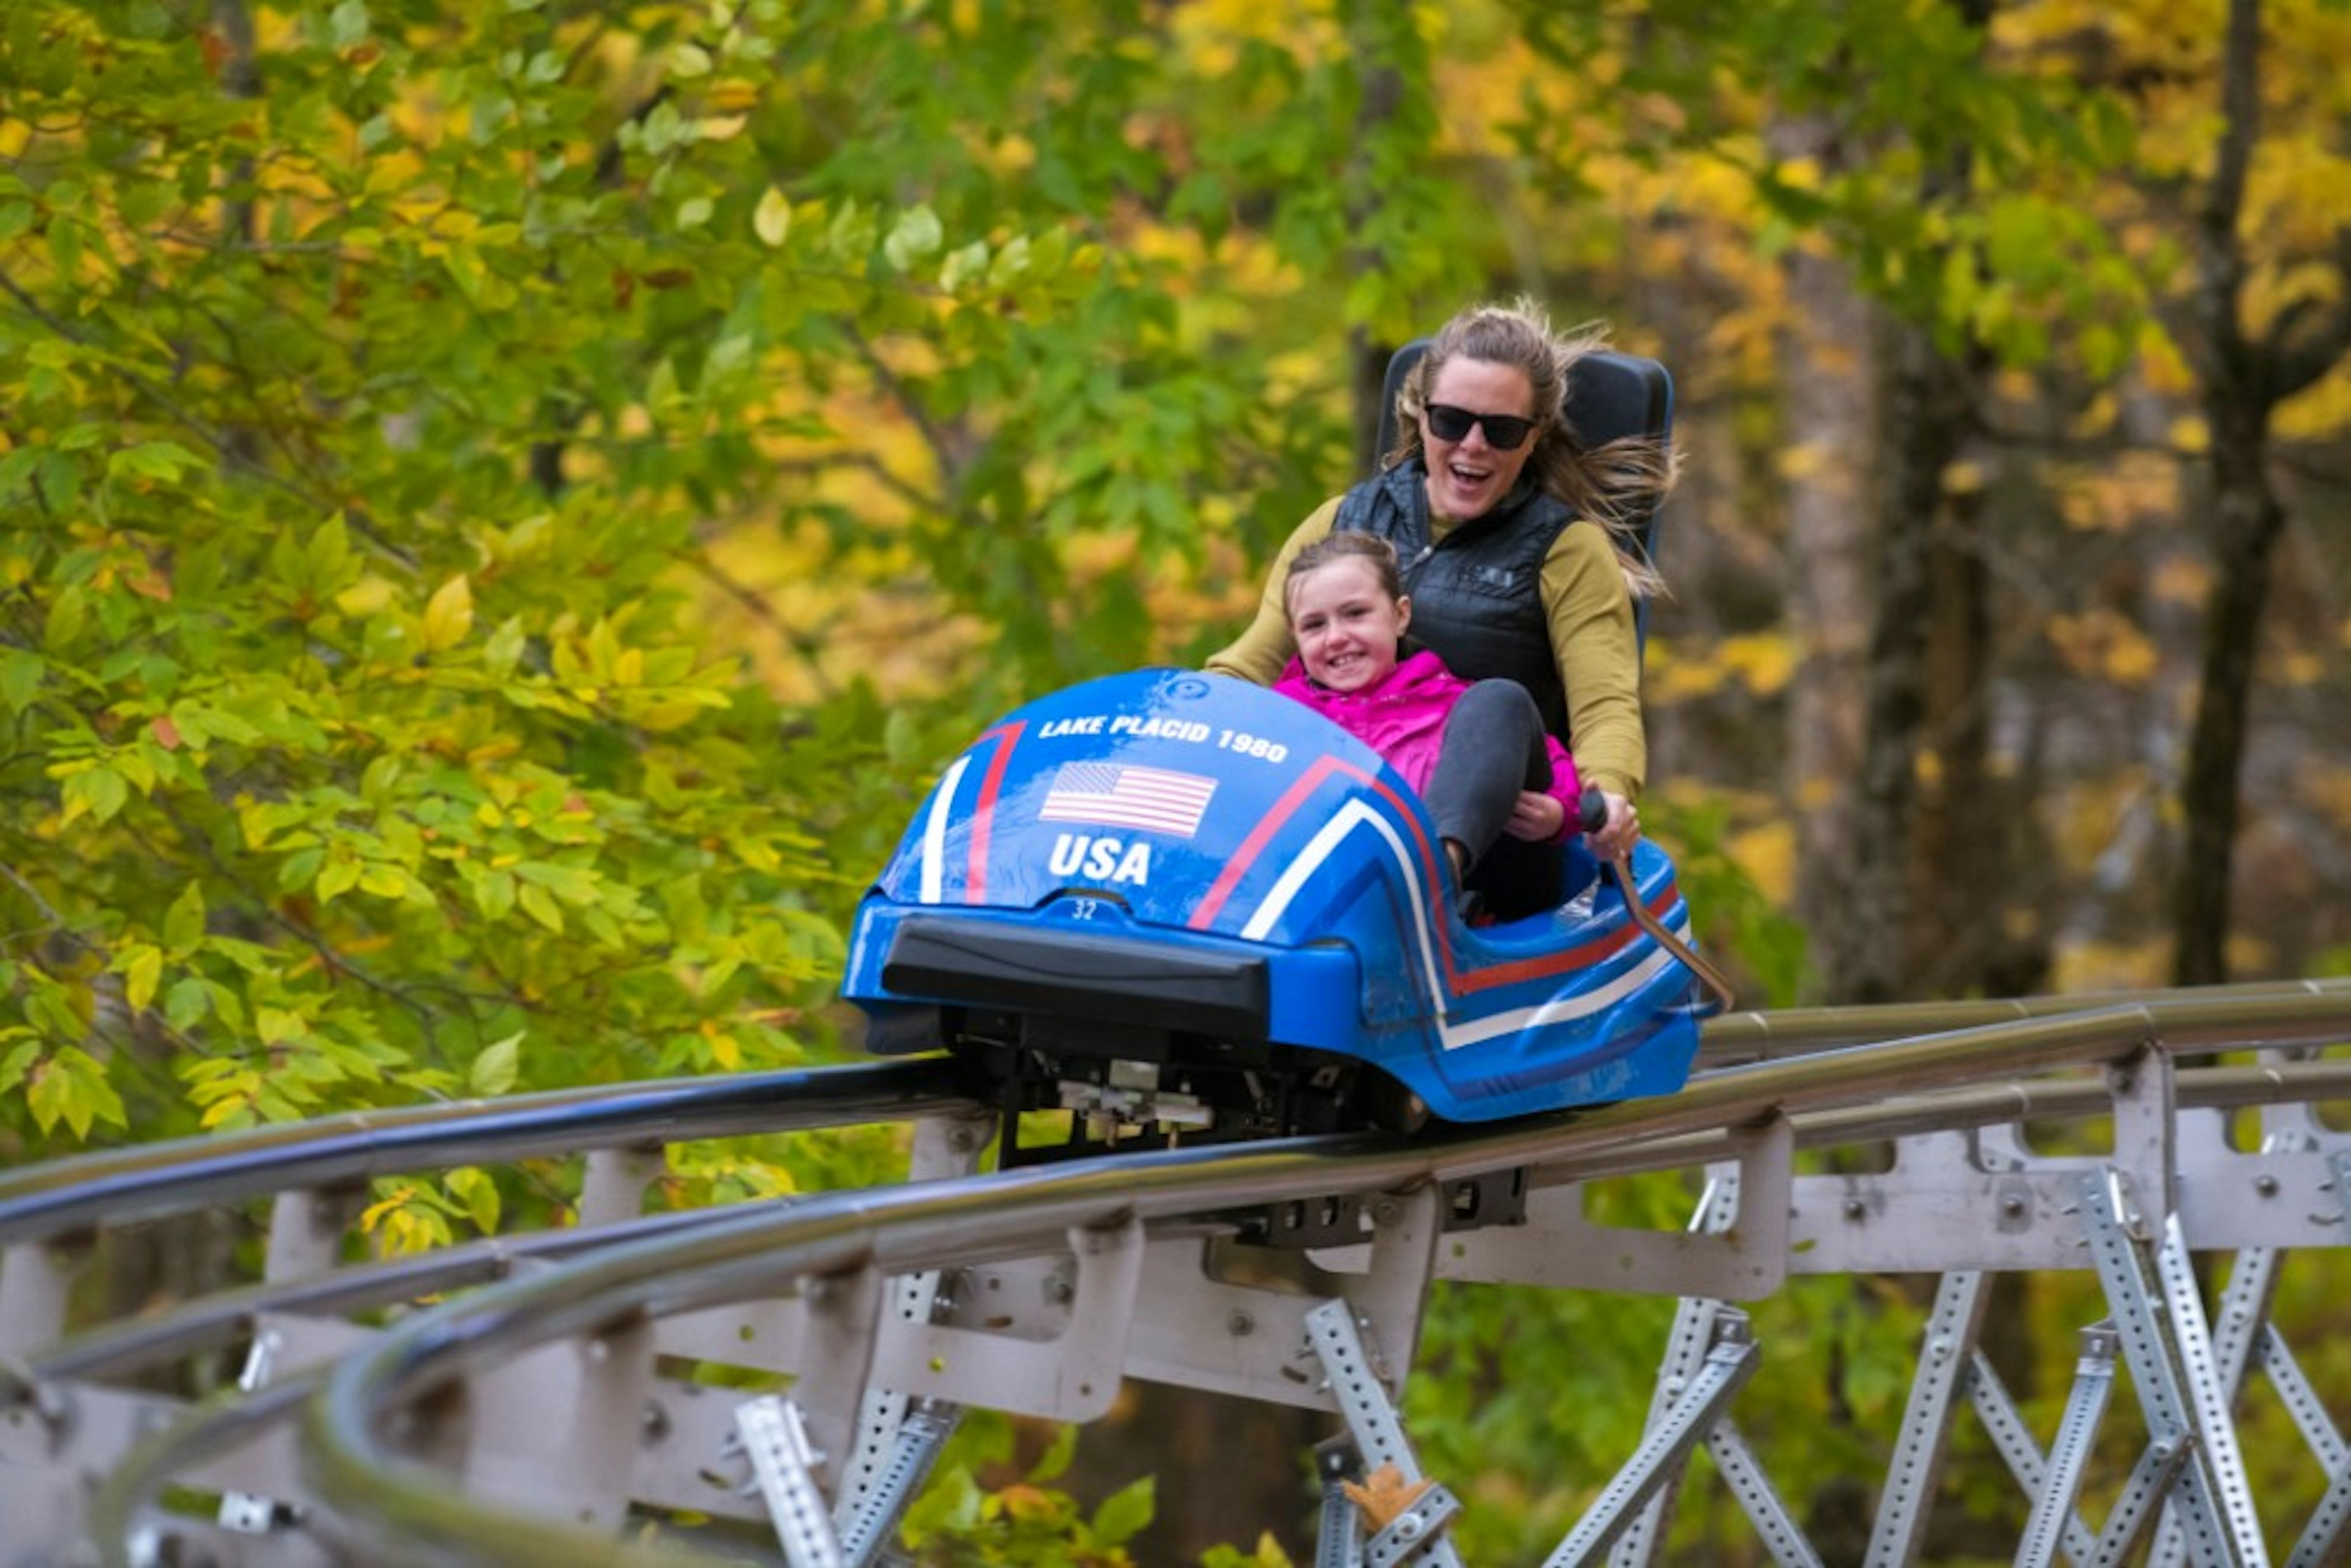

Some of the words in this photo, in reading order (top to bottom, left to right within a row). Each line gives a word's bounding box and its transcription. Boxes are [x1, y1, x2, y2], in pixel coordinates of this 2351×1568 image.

[1038, 716, 1107, 738] LAKE
[1109, 716, 1210, 743] PLACID
[1217, 730, 1288, 763] 1980
[1049, 833, 1151, 885] USA
[1071, 899, 1097, 920] 32
